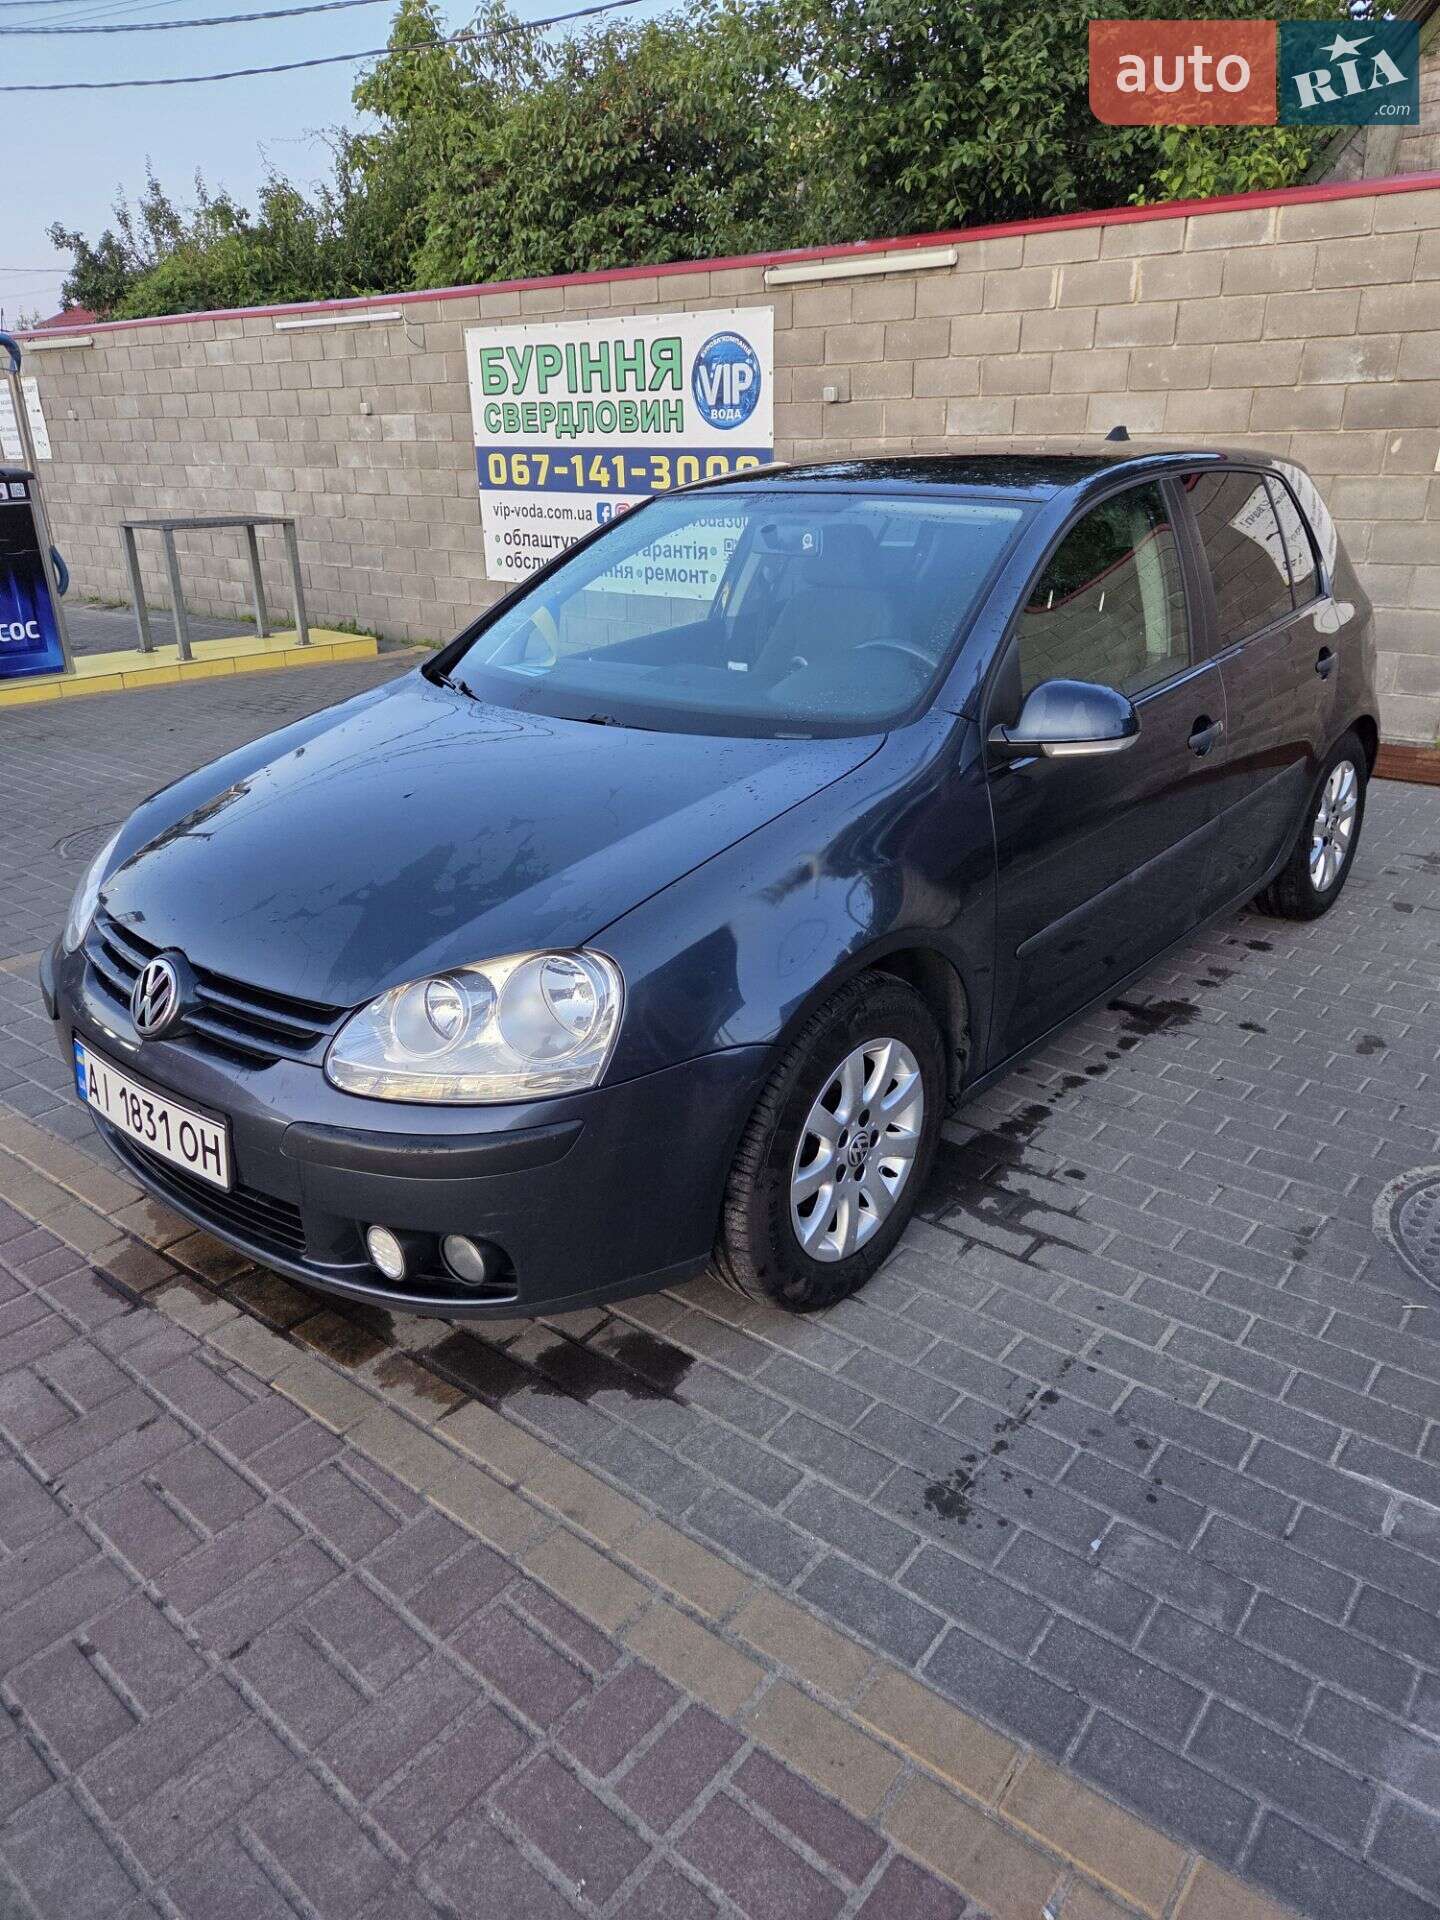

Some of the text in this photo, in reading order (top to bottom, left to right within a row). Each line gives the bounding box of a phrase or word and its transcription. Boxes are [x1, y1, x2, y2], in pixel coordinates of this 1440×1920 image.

[479, 337, 683, 396] БУРІННЯ
[699, 362, 754, 407] VIP
[484, 399, 684, 440] СВЕРДЛОВИН
[710, 408, 742, 420] ВОДА
[493, 502, 592, 520] vip-voda.com.ua
[636, 540, 708, 562] арантія
[644, 565, 708, 585] ремонт
[119, 1086, 172, 1151] 1831
